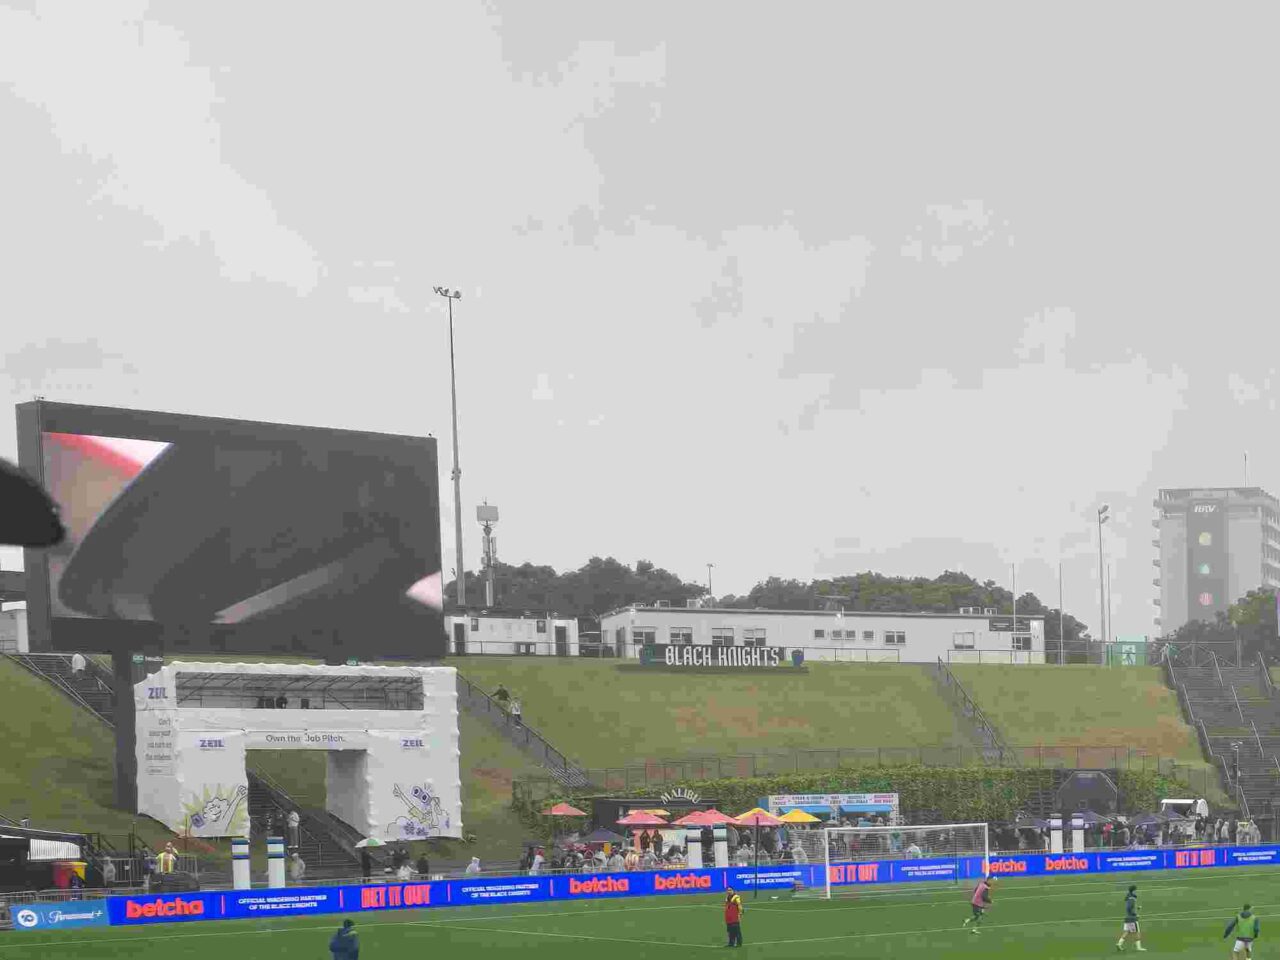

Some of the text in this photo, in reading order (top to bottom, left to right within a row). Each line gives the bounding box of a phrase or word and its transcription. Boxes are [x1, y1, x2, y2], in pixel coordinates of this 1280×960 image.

[665, 645, 779, 667] BLACK KNIGHTS
[200, 740, 224, 748] ZEIL
[402, 739, 424, 747] ZEIL
[661, 788, 701, 805] MALIBU
[1045, 856, 1088, 871] betcha
[569, 876, 629, 894] betcha
[654, 872, 711, 890] betcha
[126, 898, 204, 918] betcha
